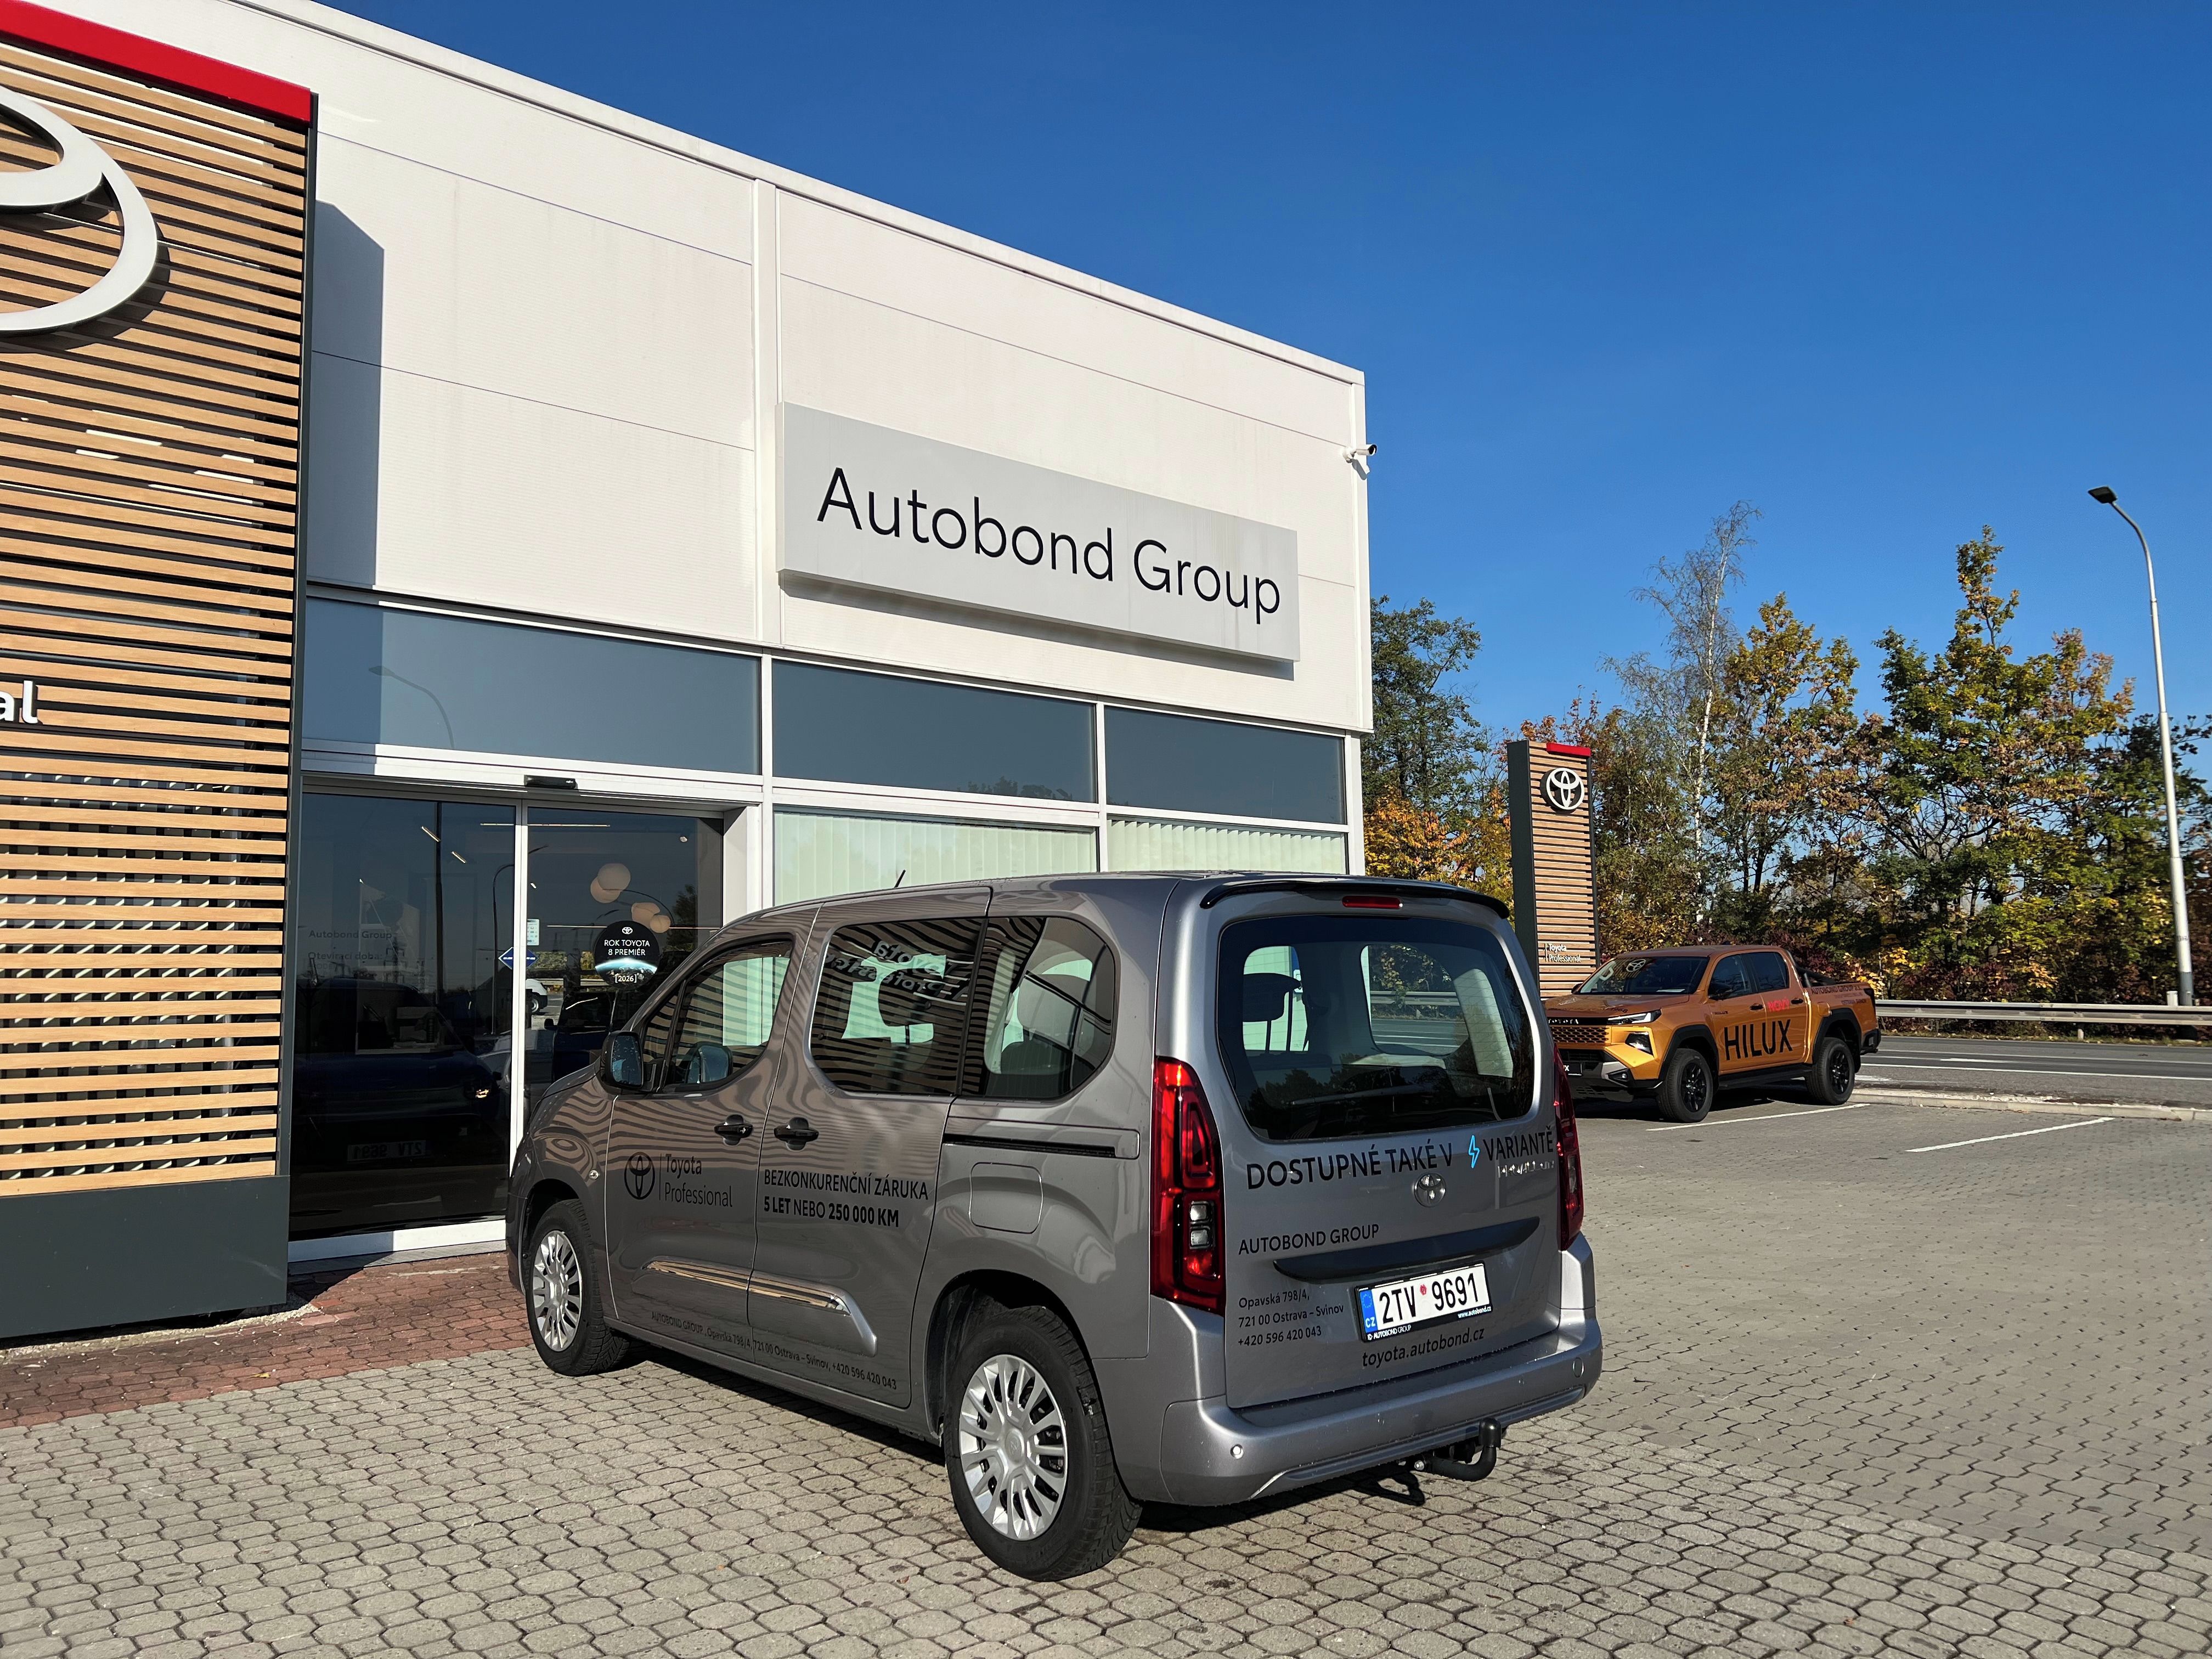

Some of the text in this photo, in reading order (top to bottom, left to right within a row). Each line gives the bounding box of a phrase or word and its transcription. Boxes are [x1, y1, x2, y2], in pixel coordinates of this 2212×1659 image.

[817, 467, 1280, 624] Autobond Group
[308, 930, 392, 940] Autobond Group
[614, 947, 646, 956] PREMIÉR
[1548, 943, 1567, 953] Toyota
[1549, 954, 1581, 962] Professional
[1724, 1019, 1793, 1060] HILUX
[665, 1154, 702, 1179] Toyota
[1246, 1126, 1554, 1189] DOSTUPNÉ TAKÉ V VARIANTĚ
[665, 1182, 732, 1207] Professional
[764, 1169, 929, 1200] BEZKONKURENČNÍ ZÁRUKA
[764, 1196, 899, 1227] 5 LET NEBO 250 000 KM
[1238, 1224, 1379, 1255] AUTOBOND GROUP
[1239, 1289, 1310, 1310] Opavská 798/4,
[1379, 1273, 1479, 1324] 2TV 9691
[1238, 1316, 1255, 1328] 721
[1259, 1314, 1270, 1325] 00
[1273, 1311, 1307, 1323] Ostrava
[1365, 1316, 1376, 1328] CZ
[1458, 1306, 1492, 1318] www.autobond.cz
[1238, 1325, 1322, 1346] +420 596 420 043
[1373, 1324, 1412, 1339] AUTOBOND GROUP
[651, 1311, 682, 1328] AUTOBOND
[682, 1321, 703, 1333] GROUP
[753, 1340, 765, 1352] 721
[765, 1344, 773, 1354] 00
[774, 1345, 800, 1361] Ostrava
[832, 1363, 849, 1375] +420
[851, 1367, 865, 1380] 596
[866, 1372, 881, 1385] 420
[882, 1376, 897, 1390] 043
[1362, 1327, 1485, 1368] toyota.autobond.cz
